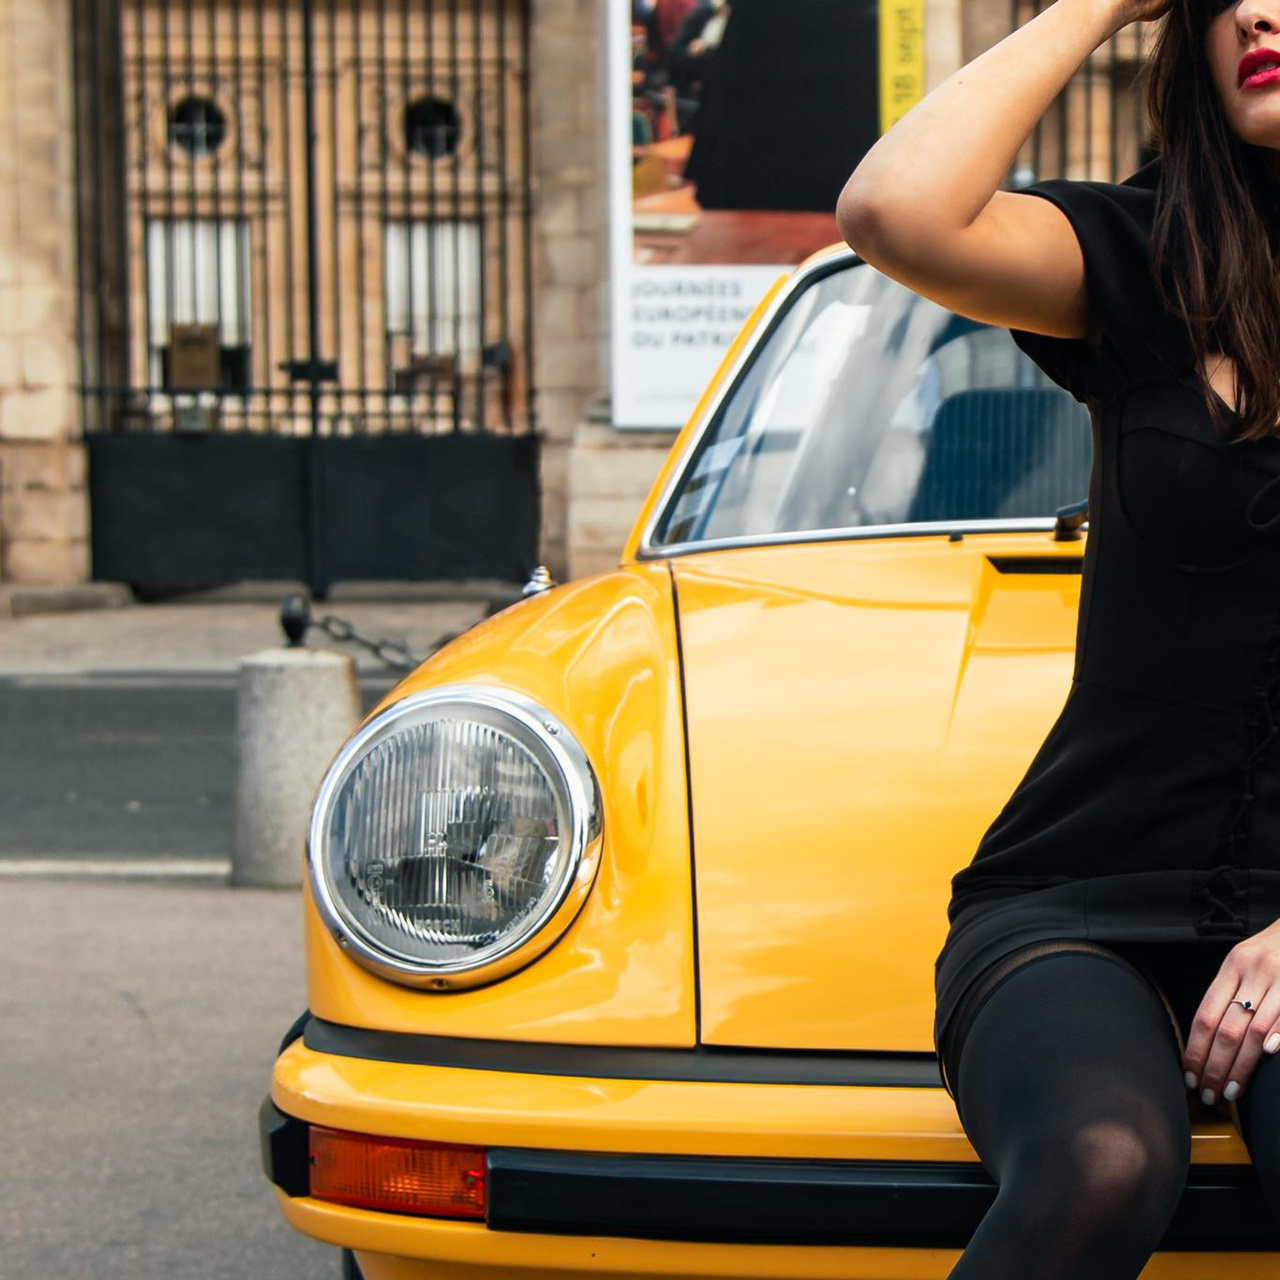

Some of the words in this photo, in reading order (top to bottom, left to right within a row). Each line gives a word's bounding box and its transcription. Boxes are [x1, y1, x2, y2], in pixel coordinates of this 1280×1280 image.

[895, 7, 923, 64] sept
[631, 277, 743, 298] JOURNÉES
[632, 329, 664, 348] DU
